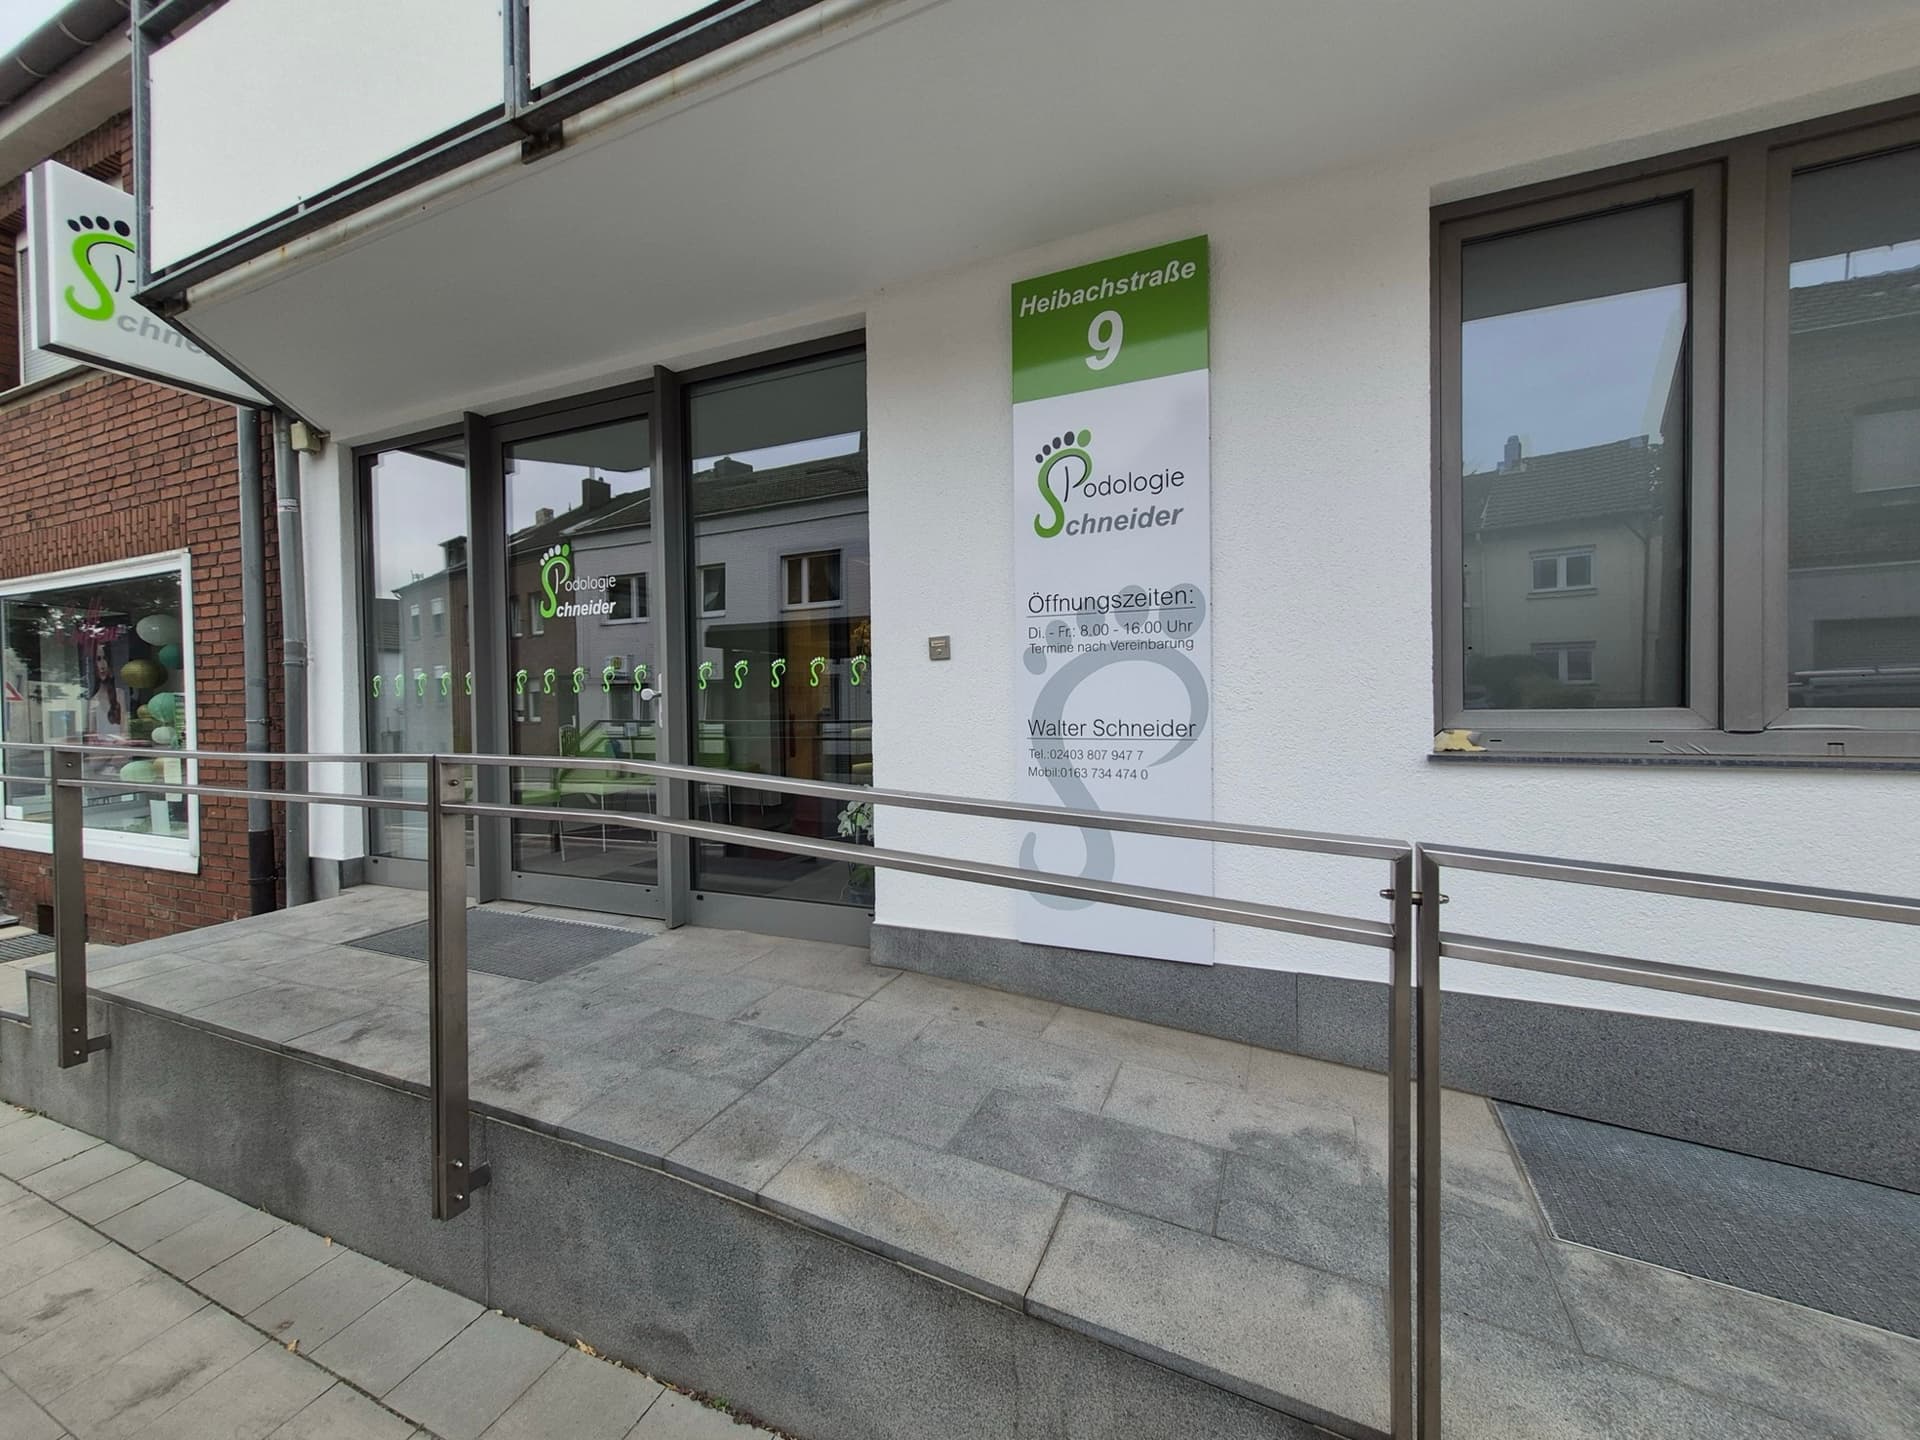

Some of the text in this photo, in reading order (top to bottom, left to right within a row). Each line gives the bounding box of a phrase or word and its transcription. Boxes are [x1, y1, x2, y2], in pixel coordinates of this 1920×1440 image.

[1019, 259, 1196, 317] Heibachstraße
[1085, 310, 1124, 371] 9
[1046, 454, 1185, 503] Podologie
[545, 560, 616, 594] Podologie
[1028, 588, 1194, 614] Öffnungszeiten:
[1028, 626, 1045, 639] Di.
[1080, 623, 1109, 637] 8.00
[1124, 620, 1162, 635] 16.00
[1167, 619, 1193, 633] Uhr
[1029, 638, 1194, 655] Termine nach Vereinbarung
[1027, 718, 1197, 737] Walter Schneider
[1087, 749, 1108, 760] 807
[1111, 750, 1133, 761] 947
[1137, 750, 1144, 761] 7
[1091, 768, 1112, 779] 734
[1115, 768, 1137, 779] 474
[1140, 769, 1149, 780] 0
